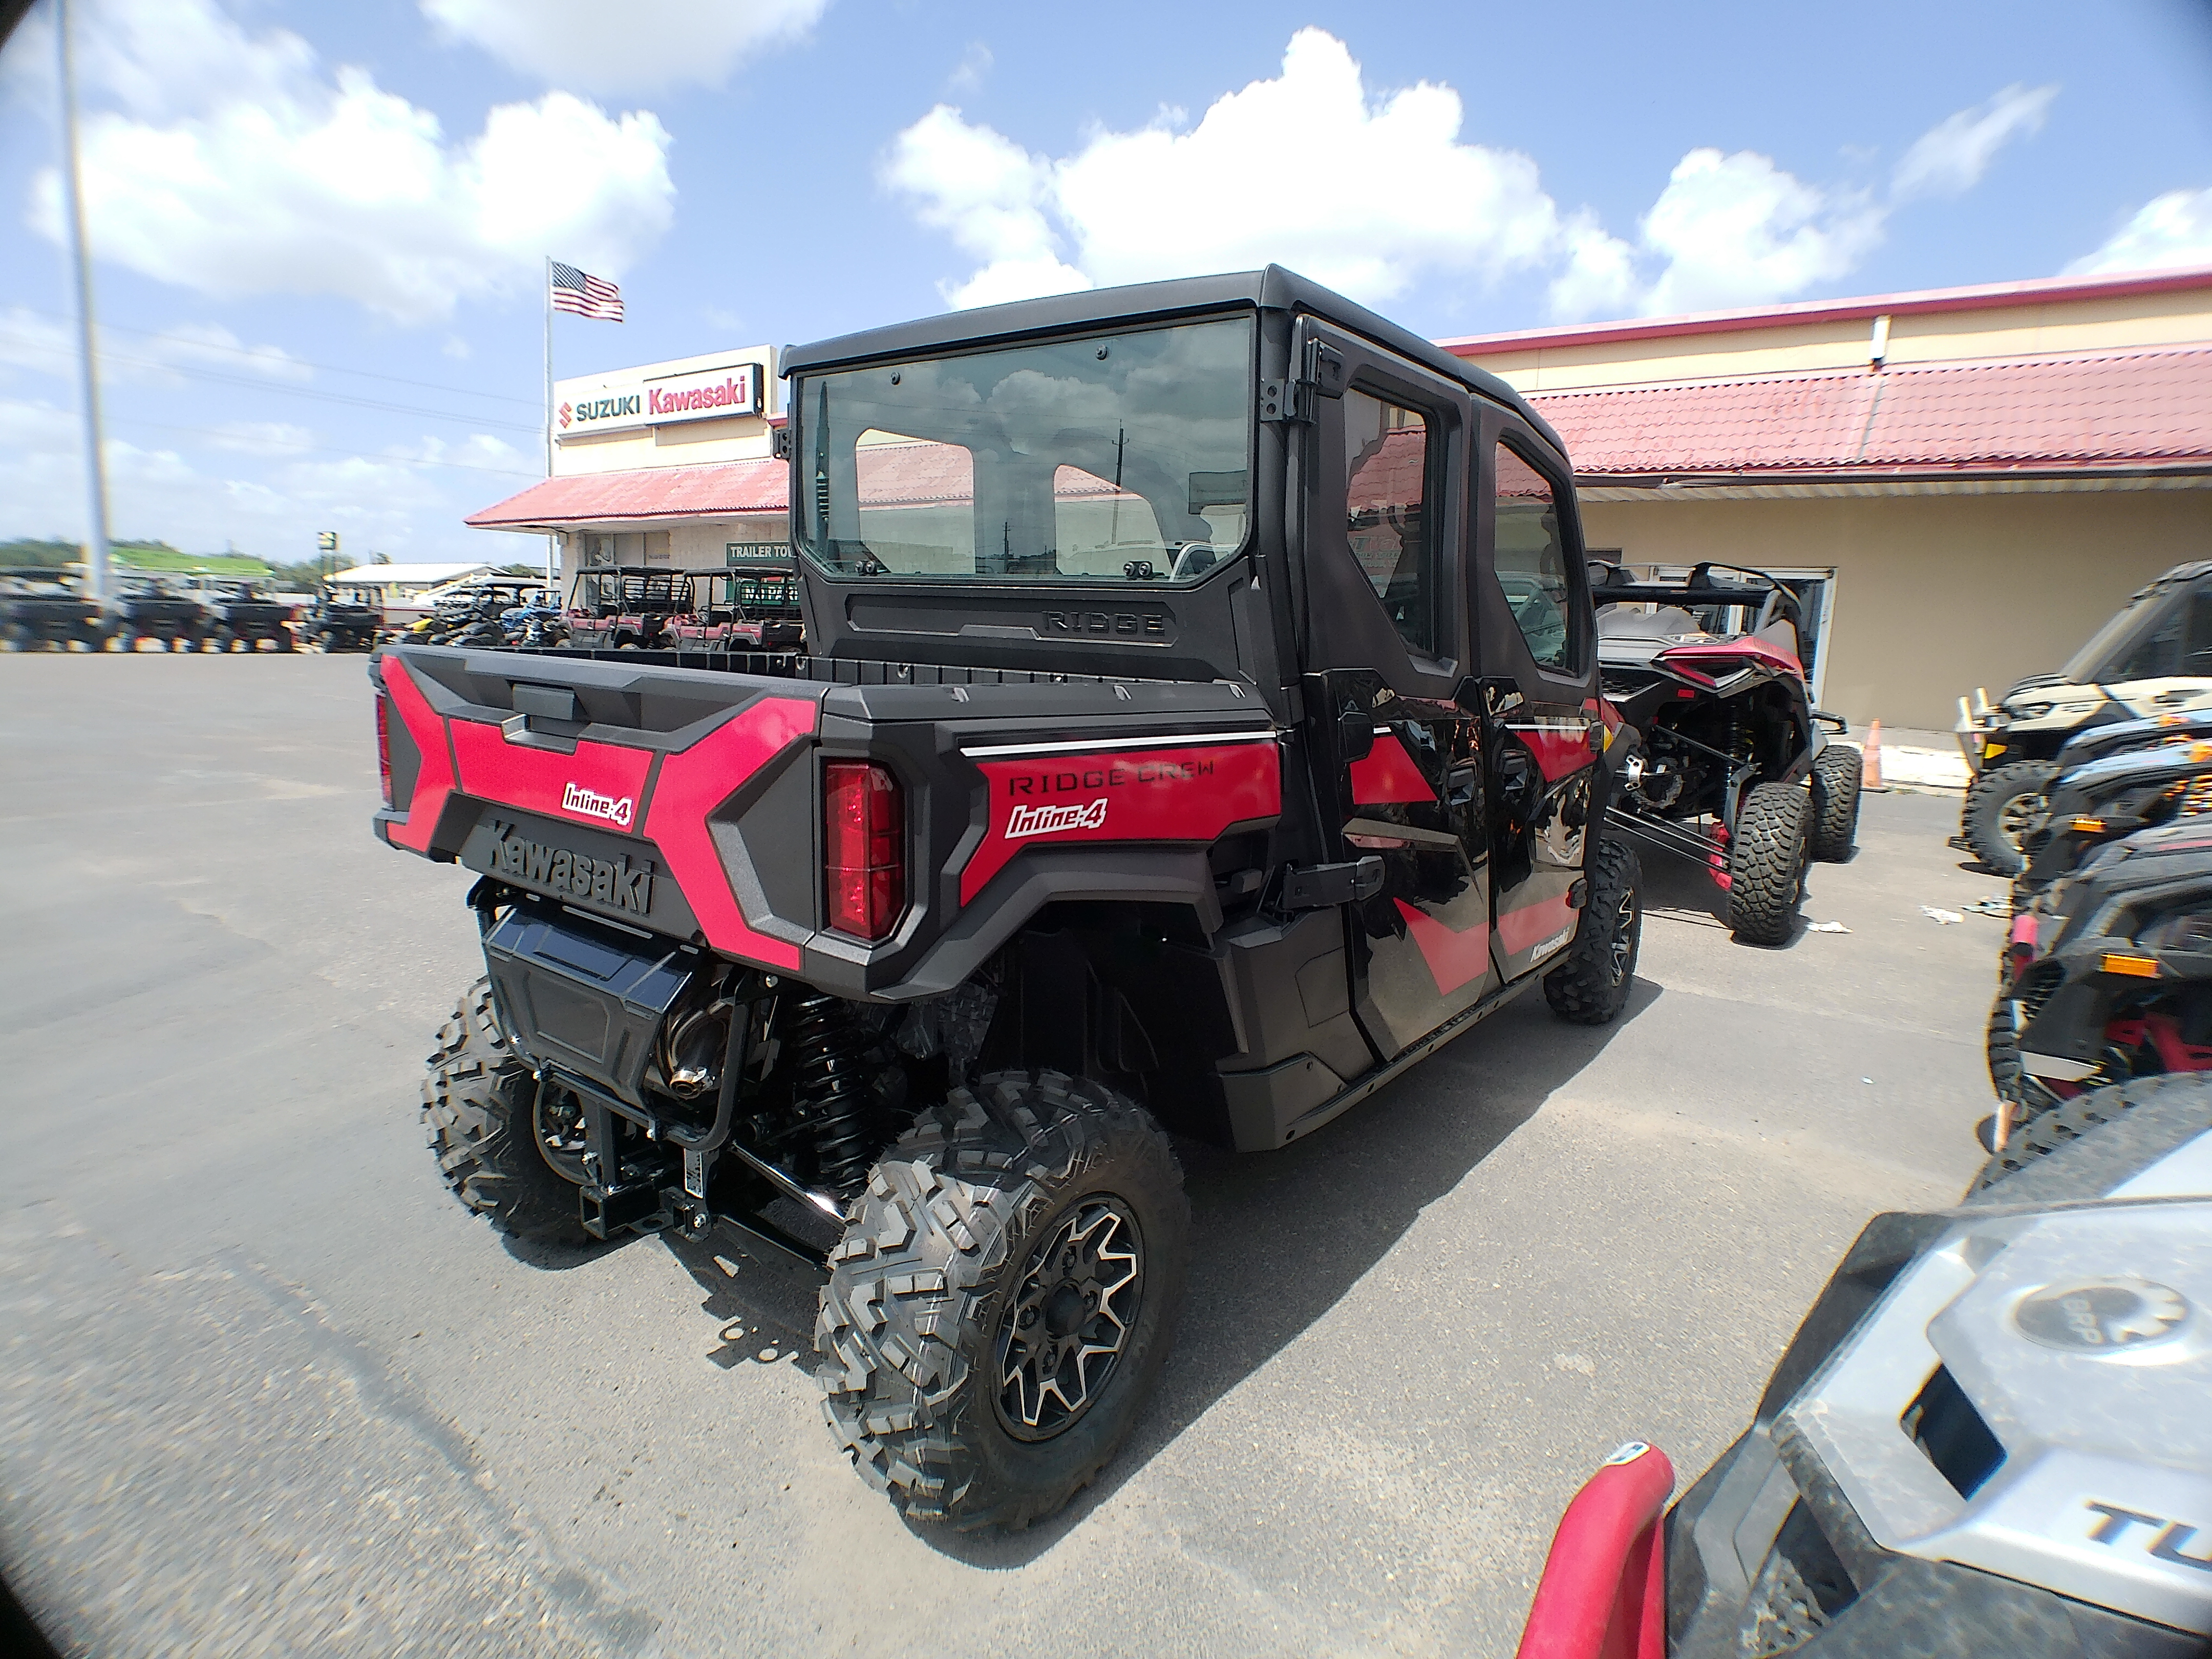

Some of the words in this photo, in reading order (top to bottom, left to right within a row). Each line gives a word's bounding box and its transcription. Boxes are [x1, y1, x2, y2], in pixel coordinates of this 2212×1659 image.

[577, 395, 640, 422] SUZUKI
[649, 375, 746, 415] Kawasaki
[730, 545, 772, 558] TRAILER
[1041, 611, 1165, 636] RIDGE
[1009, 768, 1125, 796] RIDGE
[1138, 760, 1215, 783] CREW
[488, 818, 656, 918] Kawasaki
[2061, 1298, 2104, 1345] BRP
